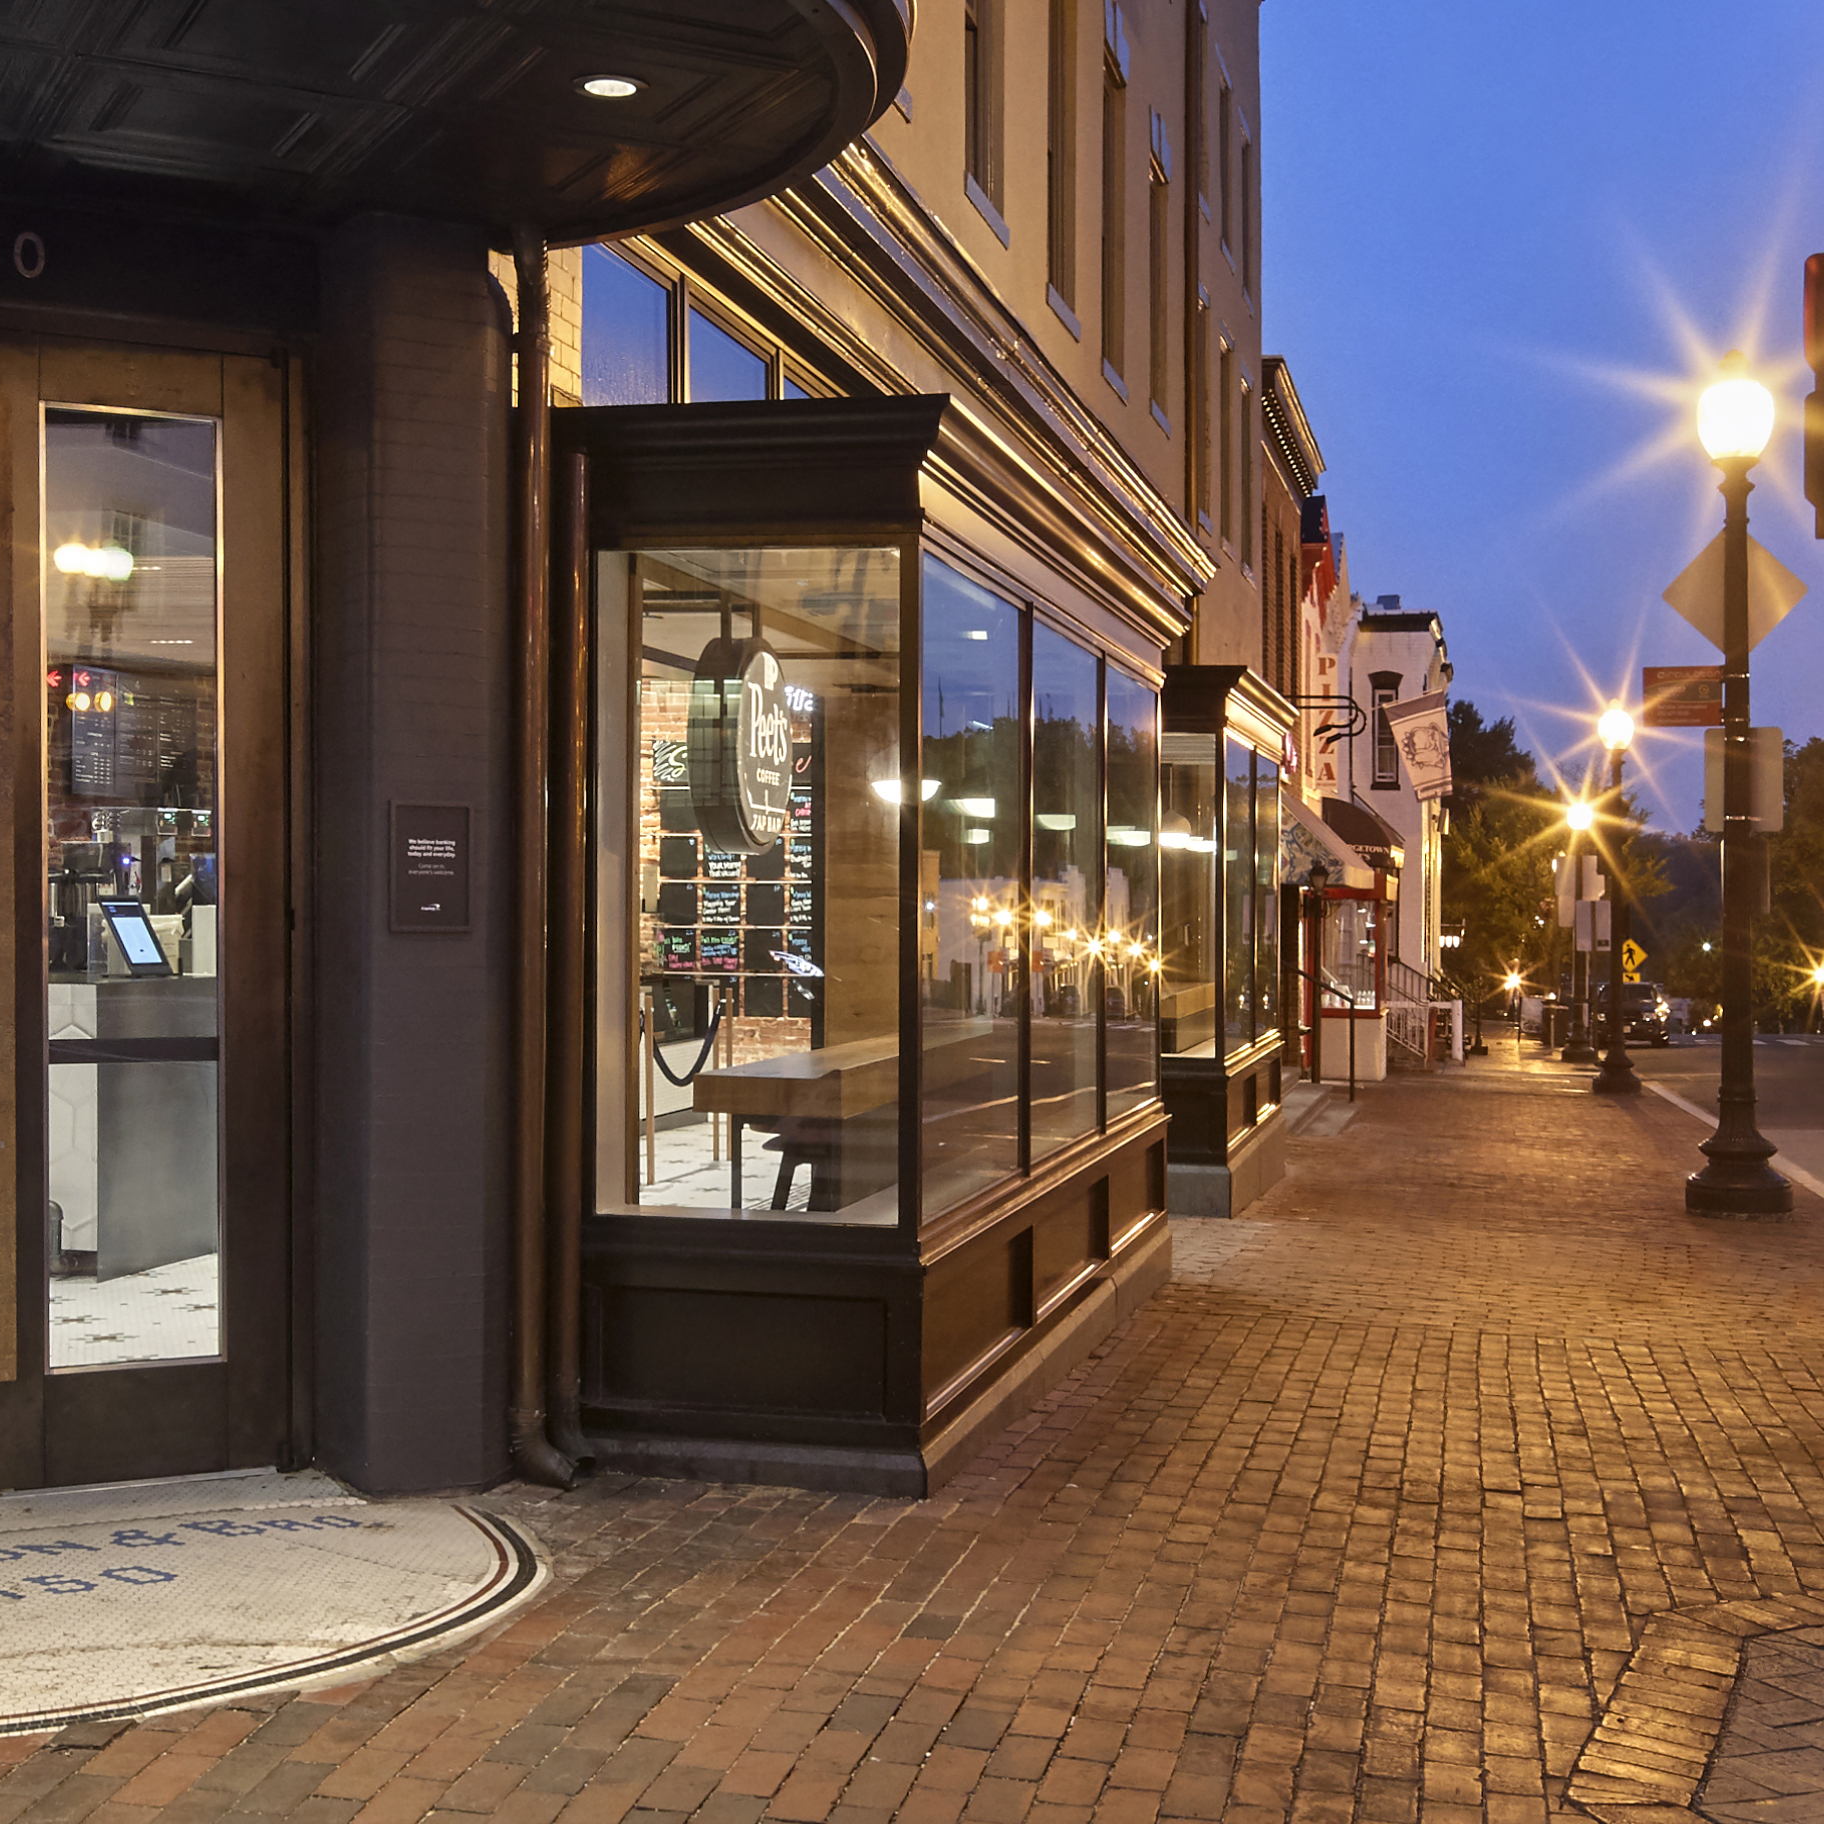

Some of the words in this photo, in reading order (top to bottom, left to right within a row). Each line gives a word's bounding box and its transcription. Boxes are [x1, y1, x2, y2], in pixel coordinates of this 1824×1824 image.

[748, 682, 788, 765] Peet's
[1317, 657, 1336, 781] PIZZA
[756, 768, 780, 786] COFFEE
[751, 814, 767, 831] TAP
[110, 1528, 186, 1548] &
